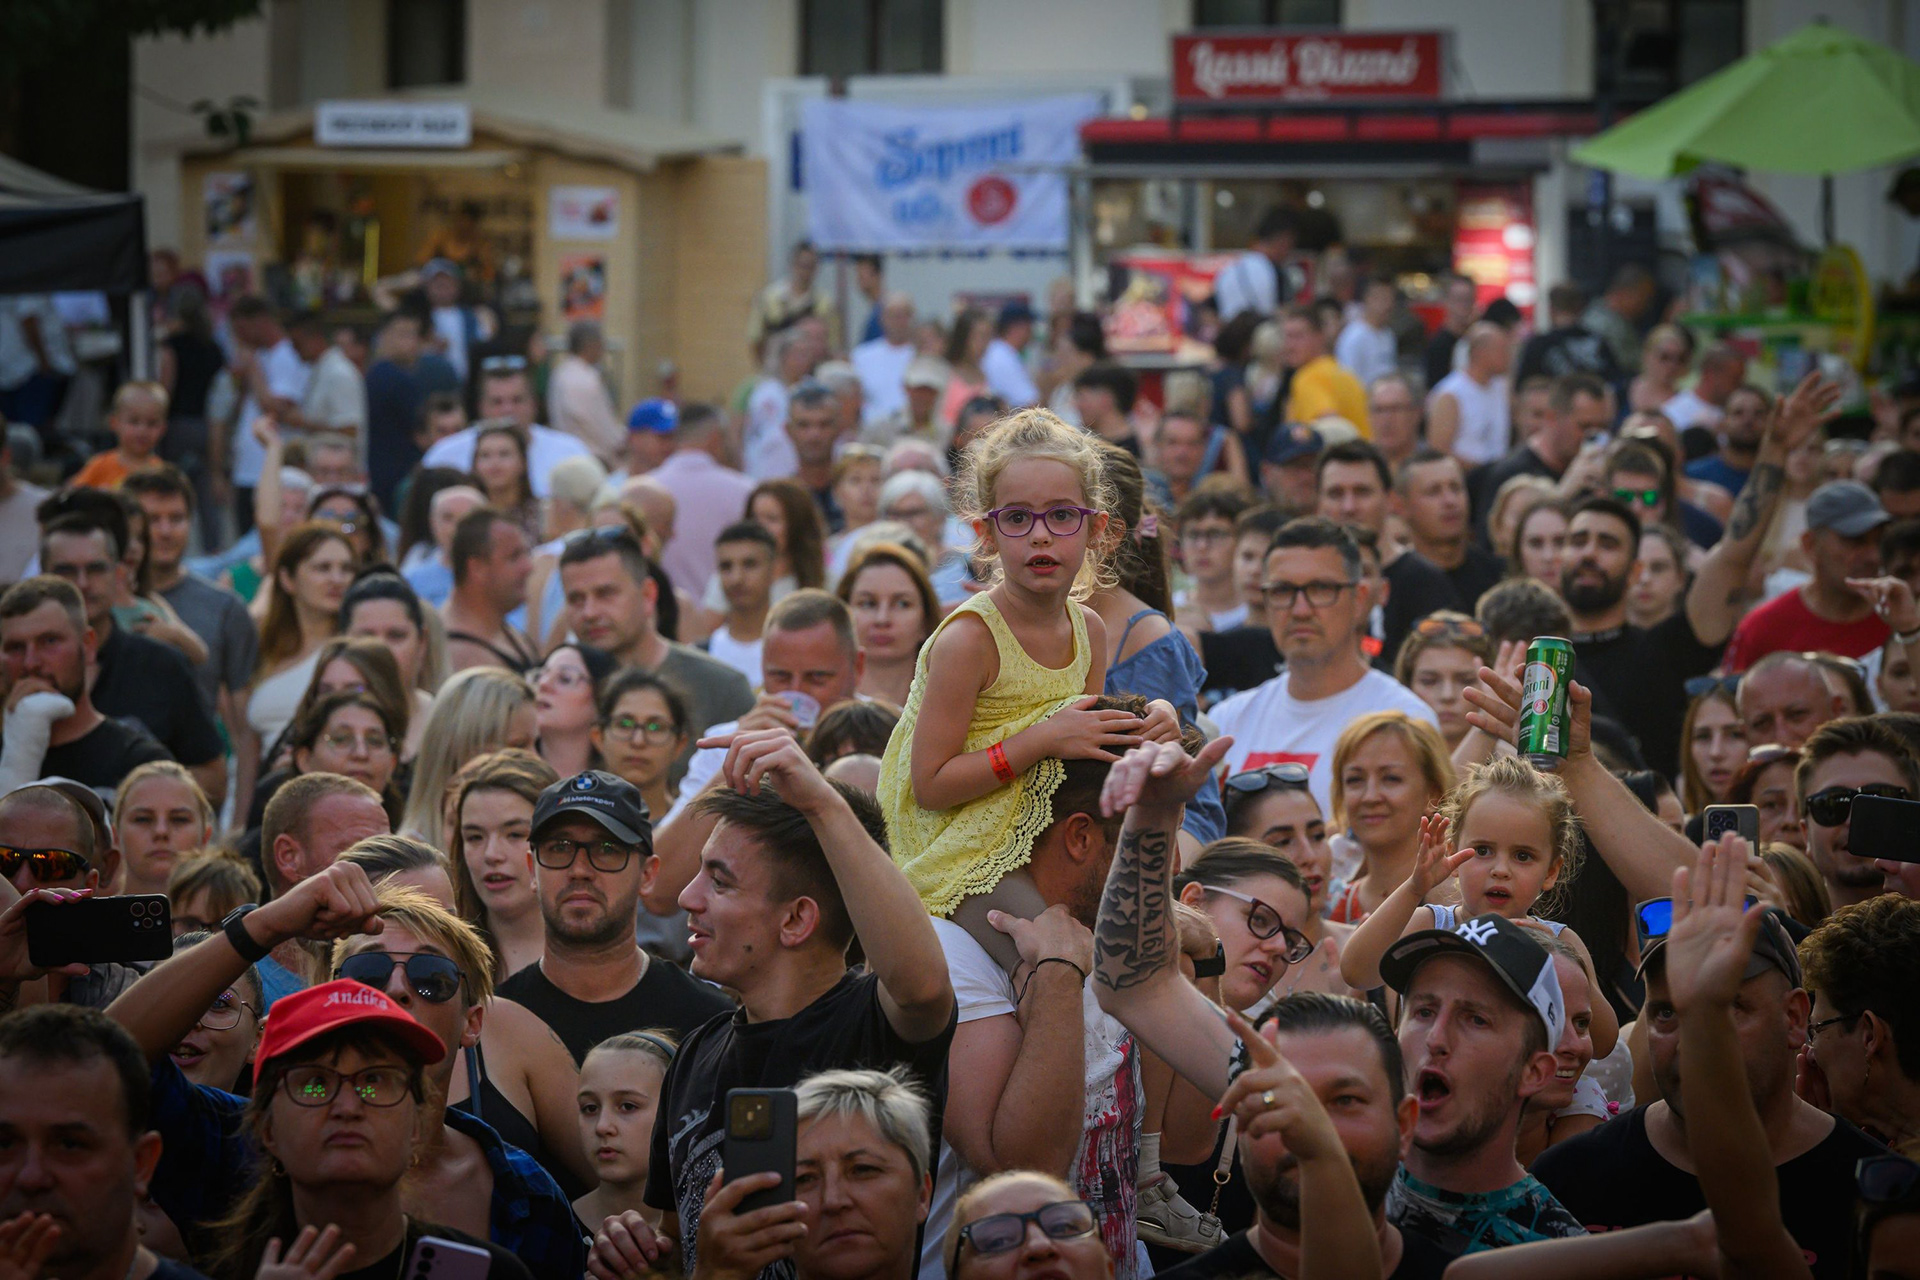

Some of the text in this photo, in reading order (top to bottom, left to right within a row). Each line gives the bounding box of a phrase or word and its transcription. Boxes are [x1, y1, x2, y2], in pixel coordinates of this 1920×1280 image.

[1524, 676, 1550, 700] proni
[571, 795, 615, 808] Motorsport
[1455, 918, 1499, 946] NY
